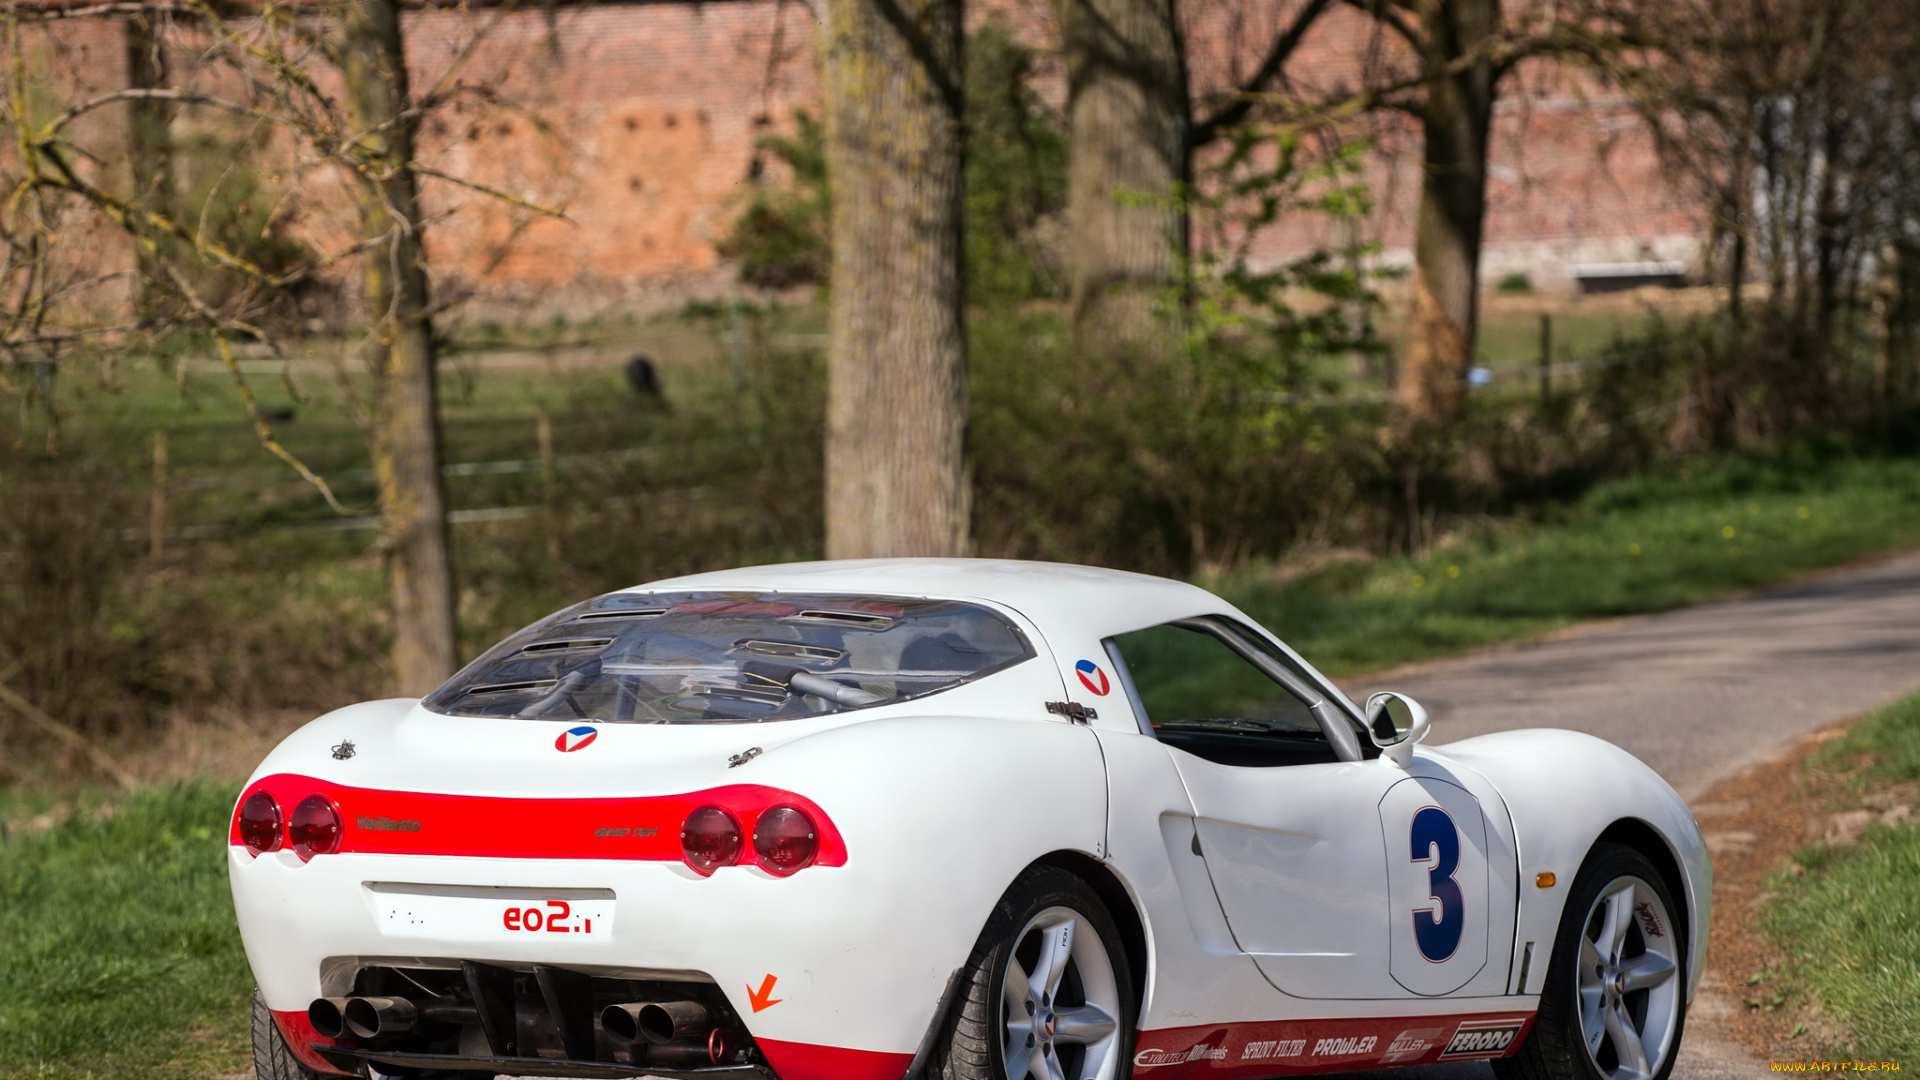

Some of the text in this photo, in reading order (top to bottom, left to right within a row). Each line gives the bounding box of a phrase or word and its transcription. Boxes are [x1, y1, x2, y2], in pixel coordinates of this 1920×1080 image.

[1409, 805, 1466, 964] 3
[1241, 1039, 1307, 1060] SPRINT FILTER
[1311, 1036, 1378, 1056] PROWLER
[1447, 1030, 1513, 1052] FERODO
